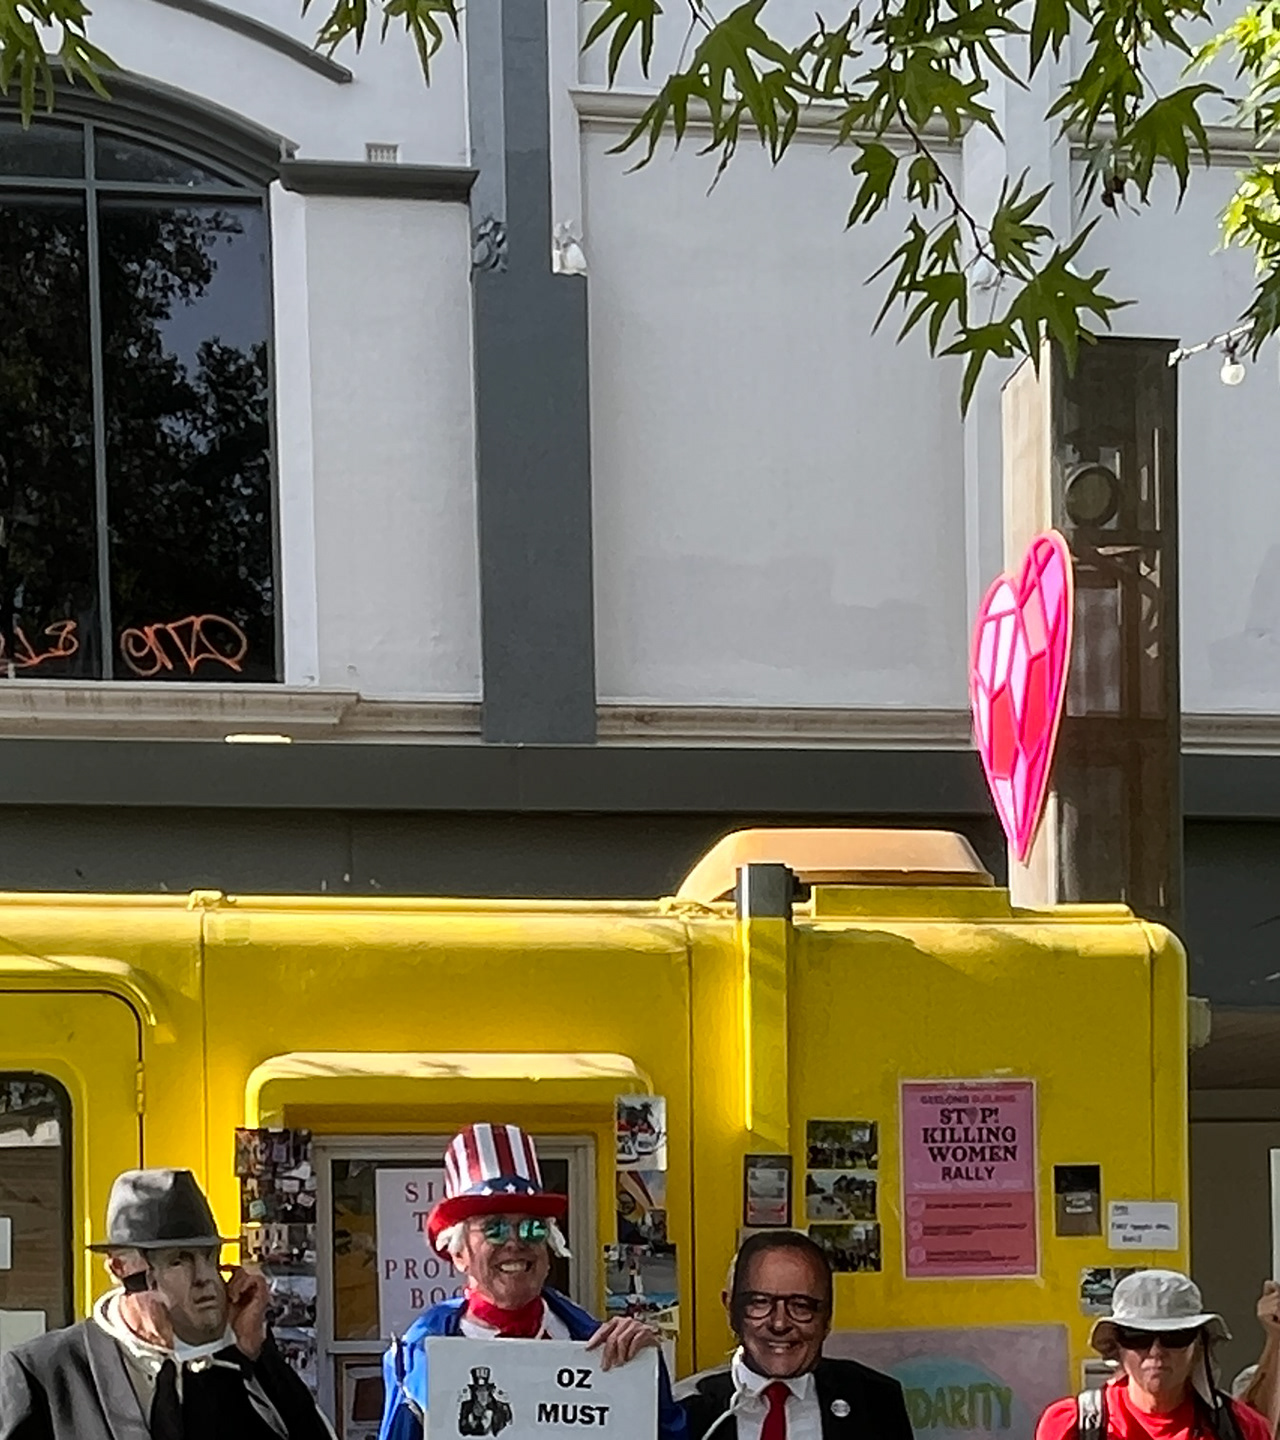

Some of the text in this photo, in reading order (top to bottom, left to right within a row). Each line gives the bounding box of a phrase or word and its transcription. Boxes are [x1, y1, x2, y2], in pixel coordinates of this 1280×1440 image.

[922, 1126, 1017, 1144] KILLING
[928, 1145, 1018, 1163] WOMEN
[941, 1166, 995, 1181] RALLY
[556, 1368, 592, 1389] OZ
[537, 1403, 609, 1426] MUST
